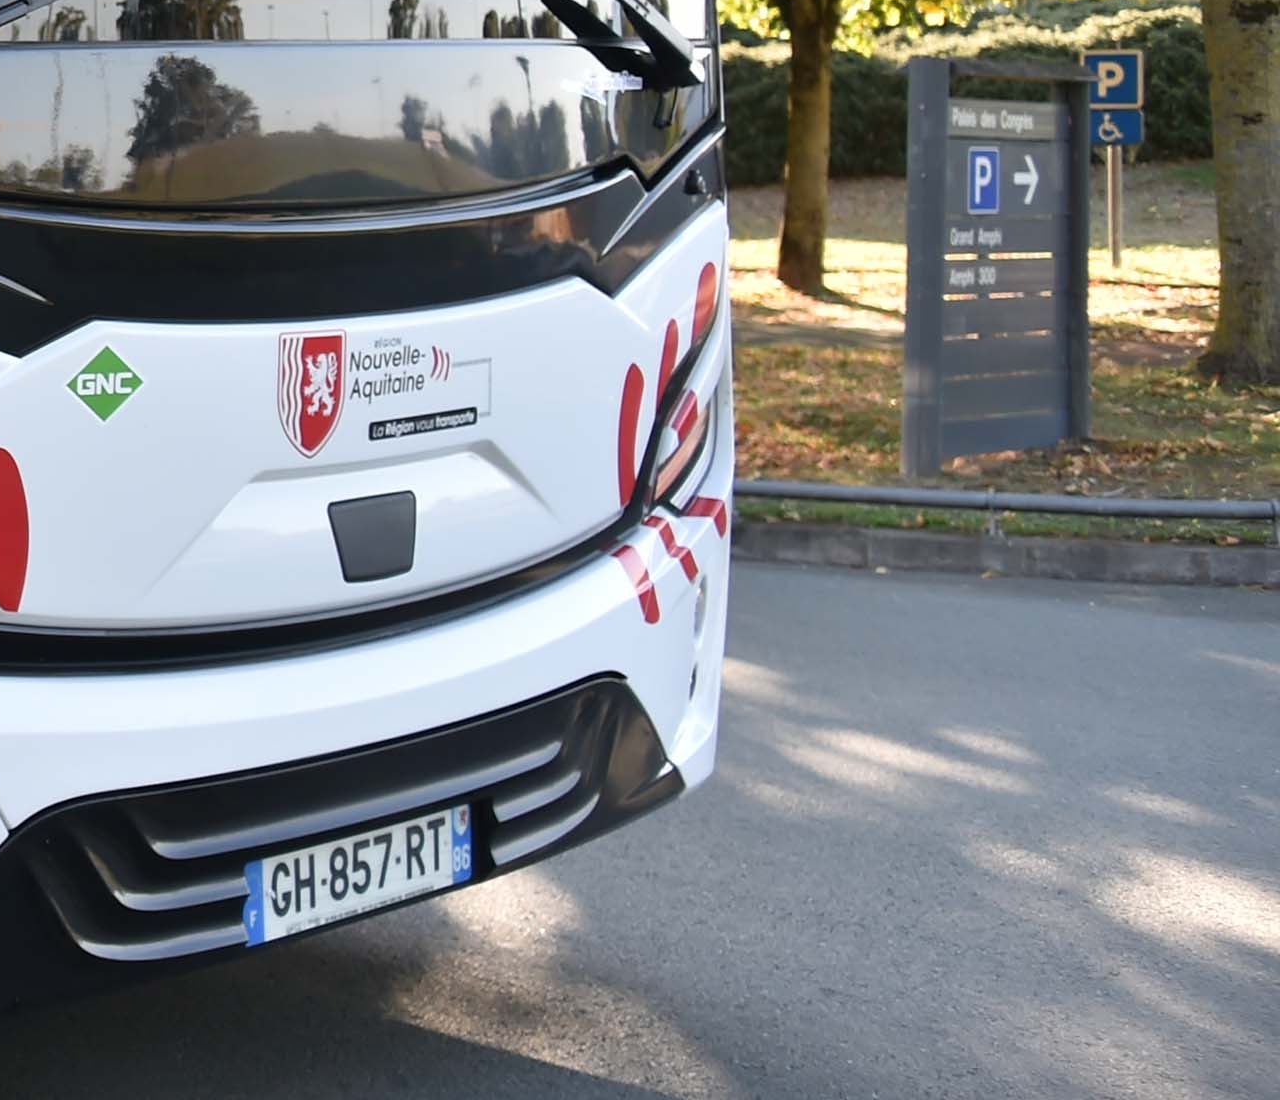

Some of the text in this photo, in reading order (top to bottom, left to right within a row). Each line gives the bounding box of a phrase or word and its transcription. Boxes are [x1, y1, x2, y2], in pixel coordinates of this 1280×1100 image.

[975, 156, 992, 205] P
[349, 345, 426, 373] Nouvelle-
[76, 372, 134, 396] GNC
[349, 371, 425, 404] Aquitaine
[385, 419, 415, 437] Région
[271, 817, 446, 918] GH-857-RT
